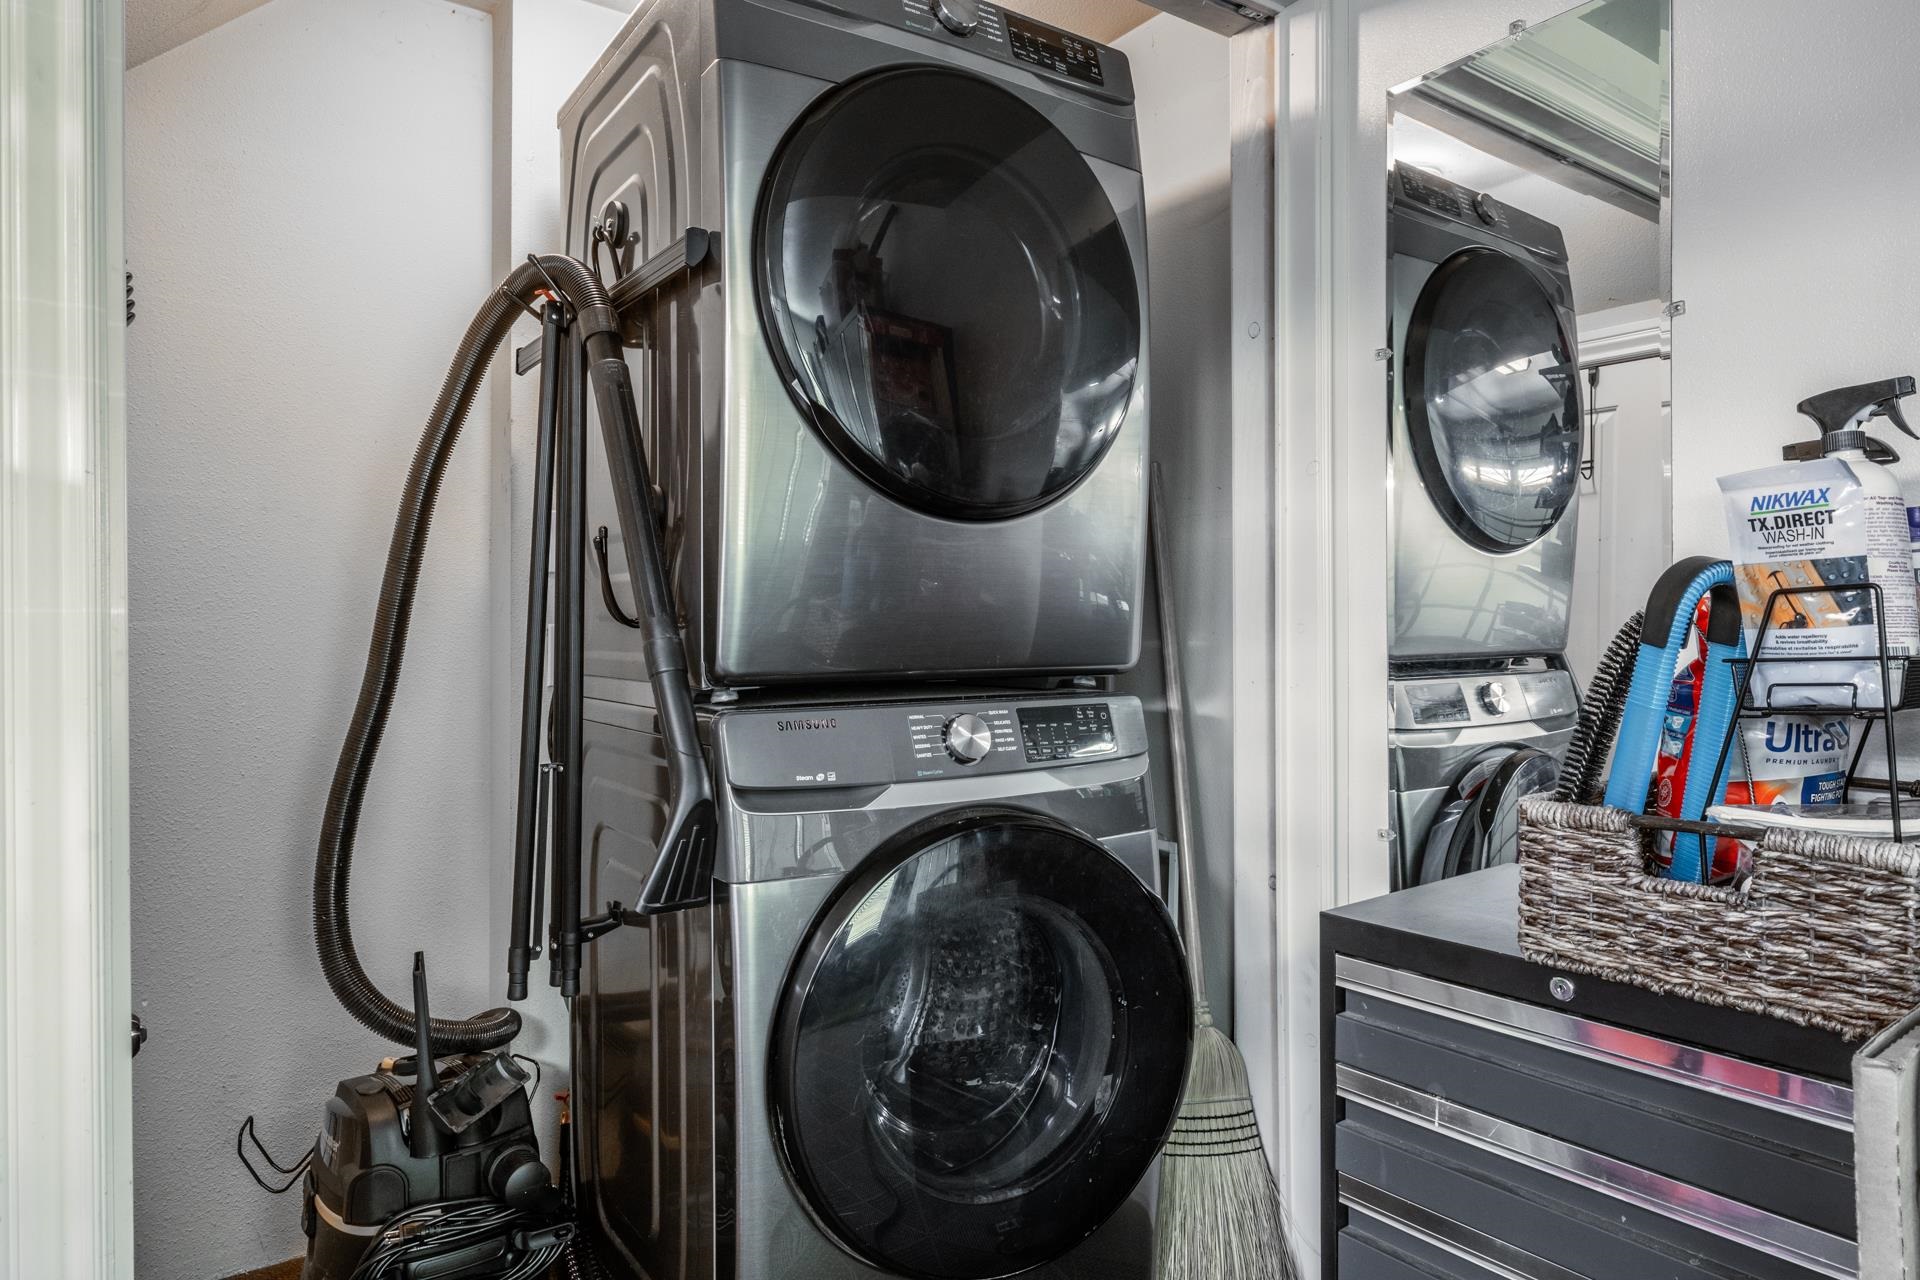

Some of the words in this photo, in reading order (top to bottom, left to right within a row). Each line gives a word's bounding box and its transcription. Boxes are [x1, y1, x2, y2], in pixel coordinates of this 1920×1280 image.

[1750, 487, 1831, 512] NIKWAX
[1747, 509, 1836, 532] TX.DIRECT
[1762, 526, 1825, 544] WASH-IN
[777, 718, 837, 731] SAMSUNG
[1765, 721, 1837, 753] Ultra
[1766, 758, 1808, 766] PREMIUM
[1818, 780, 1837, 791] TOUGH
[1810, 791, 1836, 803] FIGHTING
